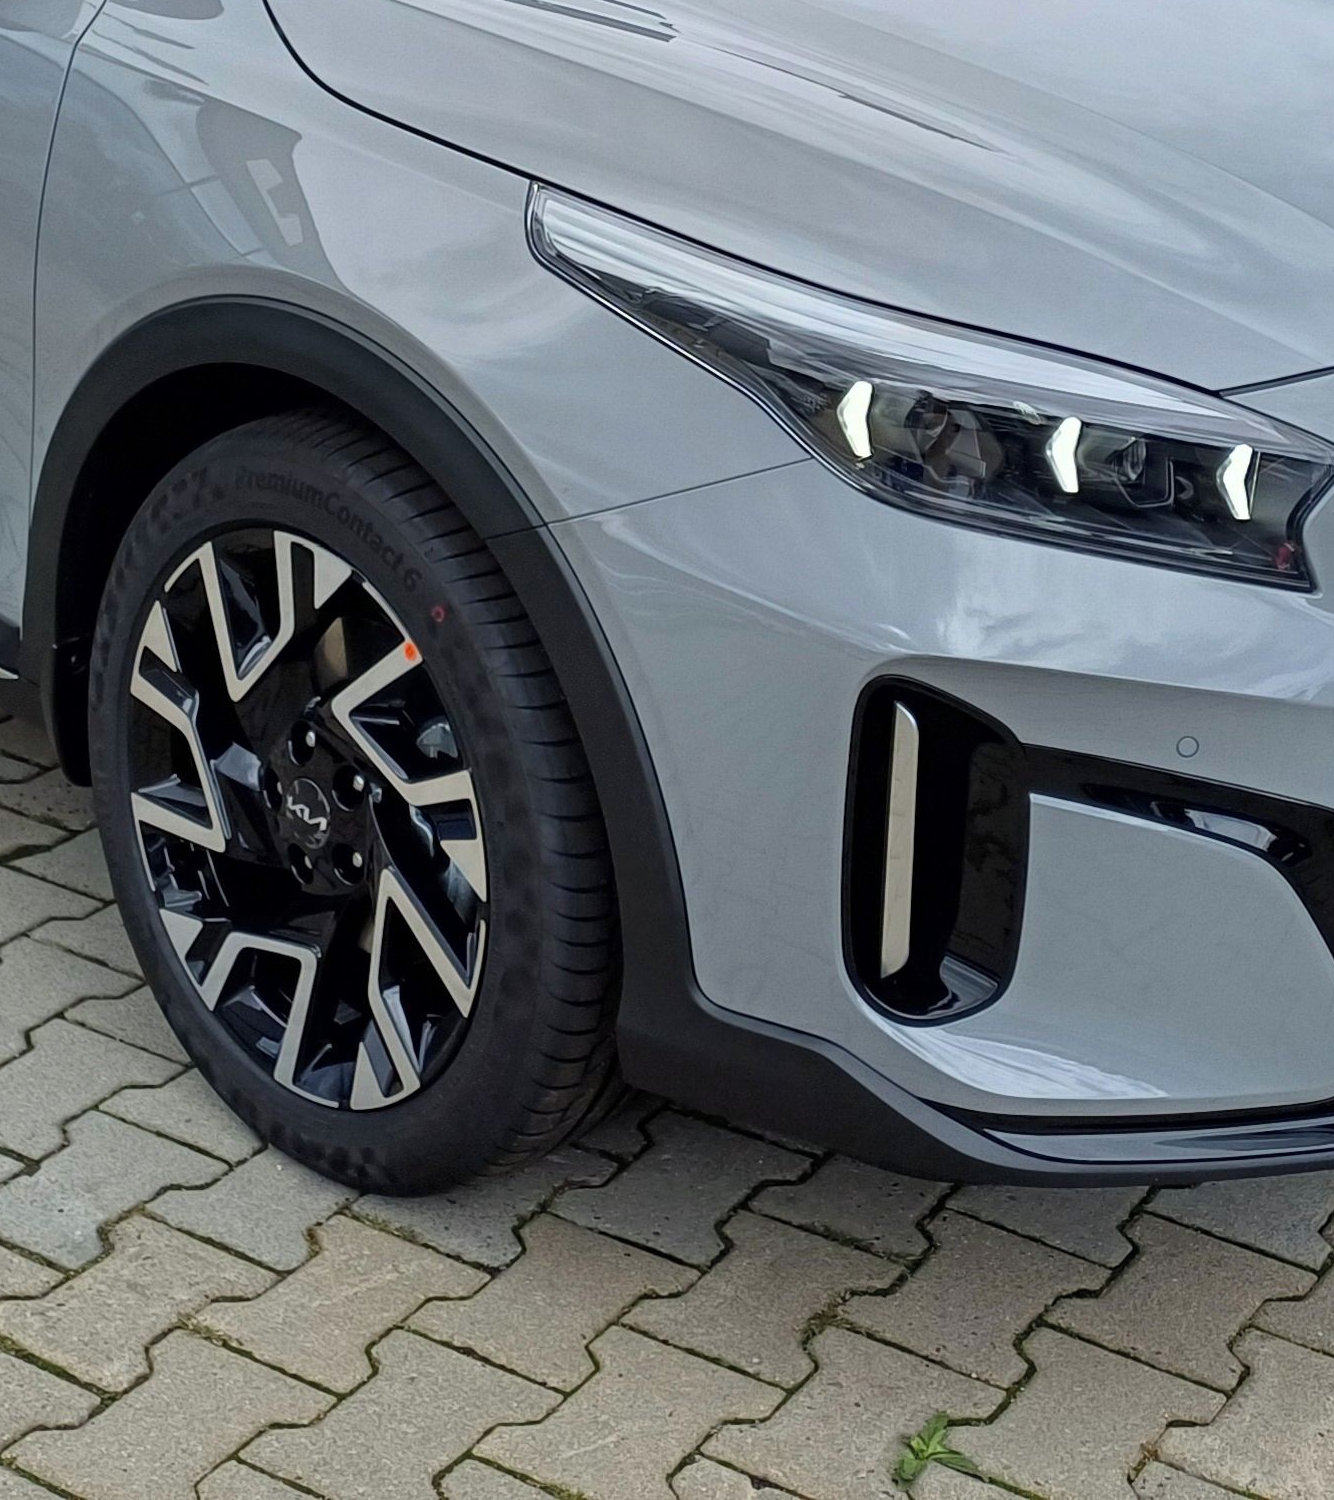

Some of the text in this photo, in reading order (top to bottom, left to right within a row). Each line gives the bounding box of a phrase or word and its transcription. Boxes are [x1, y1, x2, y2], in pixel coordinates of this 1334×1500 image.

[235, 466, 423, 592] PremiumContact 6
[286, 794, 328, 832] KIA
